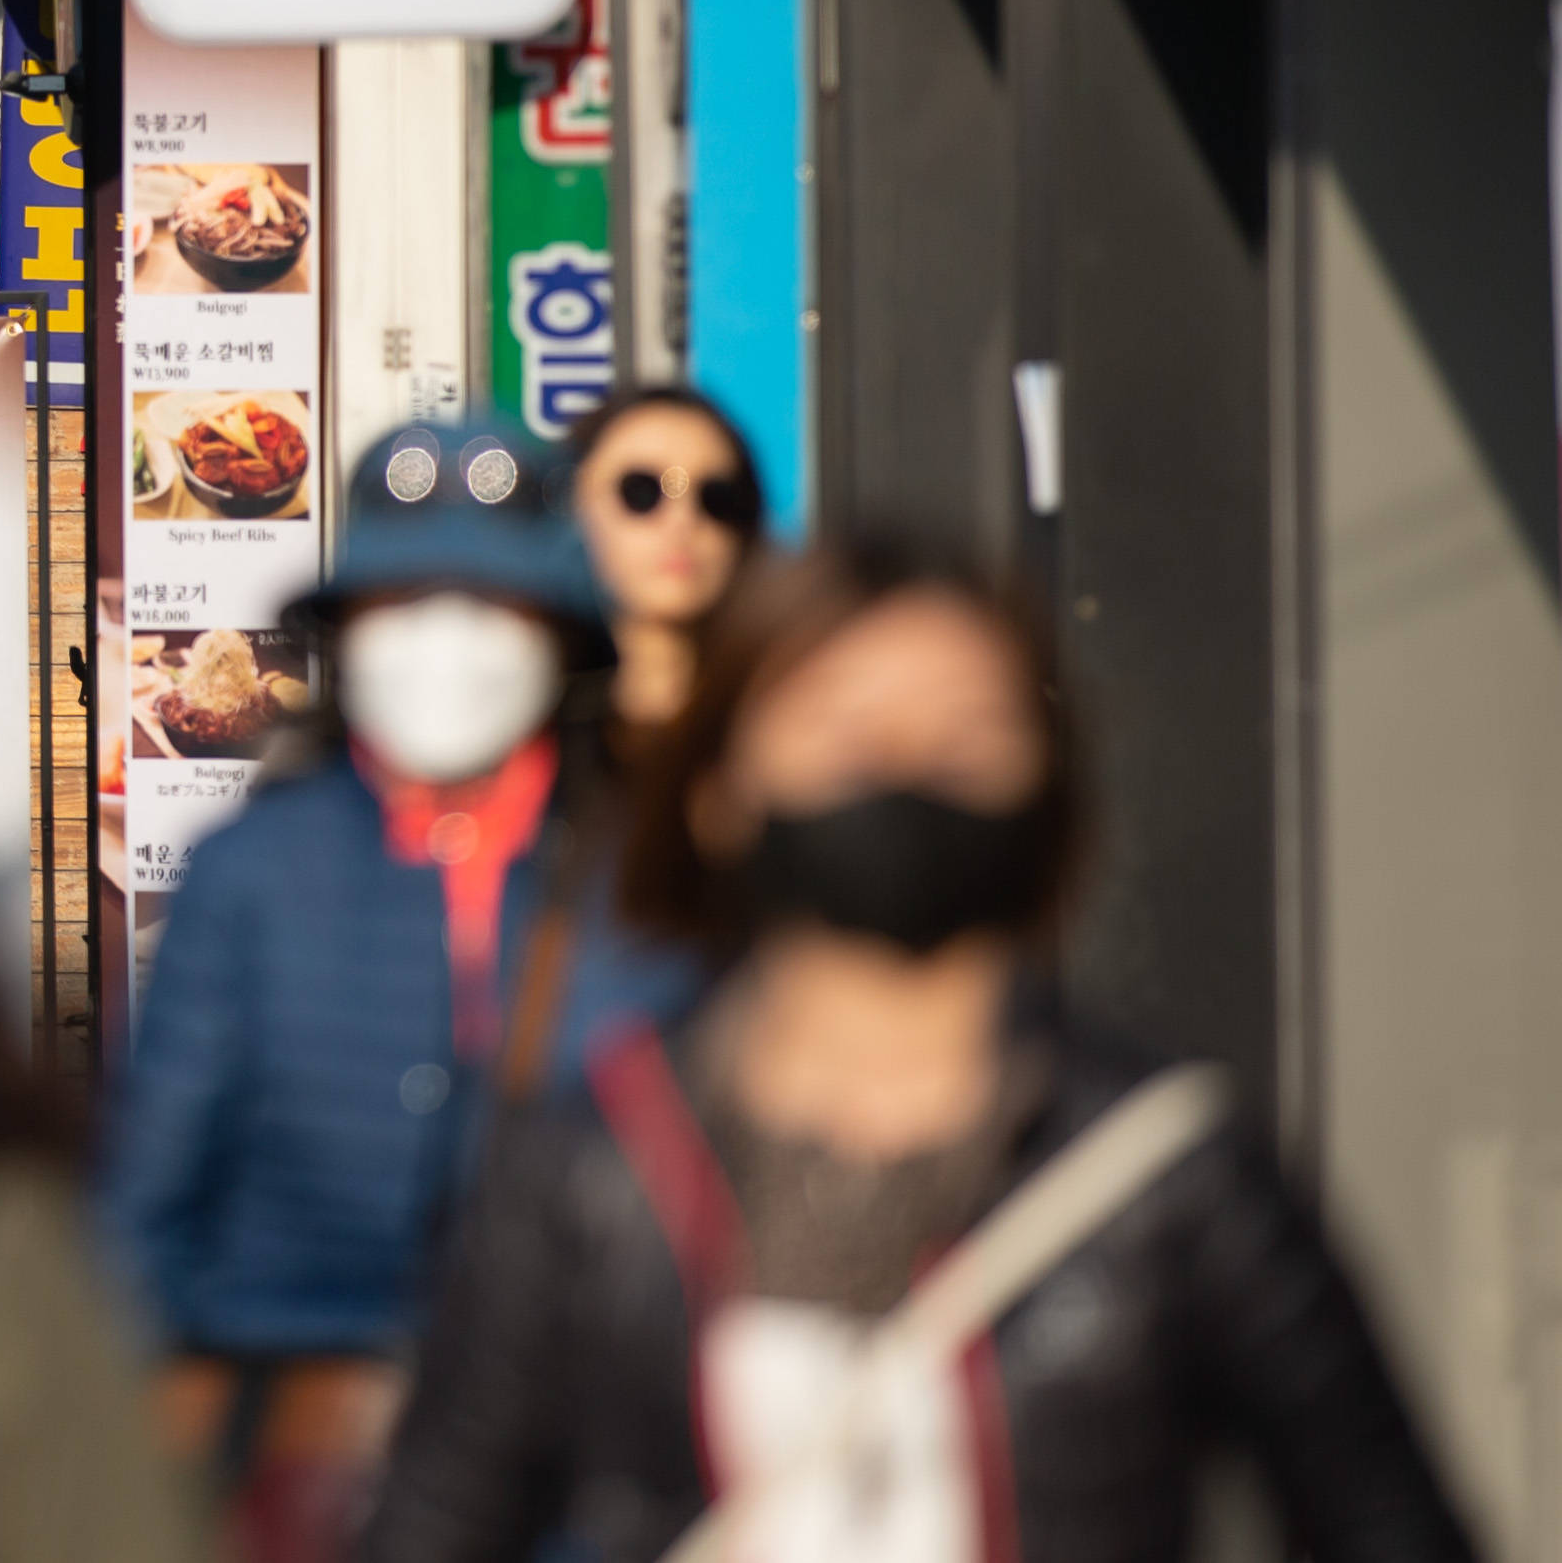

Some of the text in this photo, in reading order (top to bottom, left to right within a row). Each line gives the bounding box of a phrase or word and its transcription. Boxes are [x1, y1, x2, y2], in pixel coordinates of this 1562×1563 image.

[197, 300, 248, 316] Bulgogi
[168, 528, 276, 545] Spicy Beef Ribs
[132, 583, 207, 604] 파불고기
[194, 766, 245, 783] Bulgogi
[135, 844, 173, 865] 매운
[135, 867, 188, 884] ₩19,00
